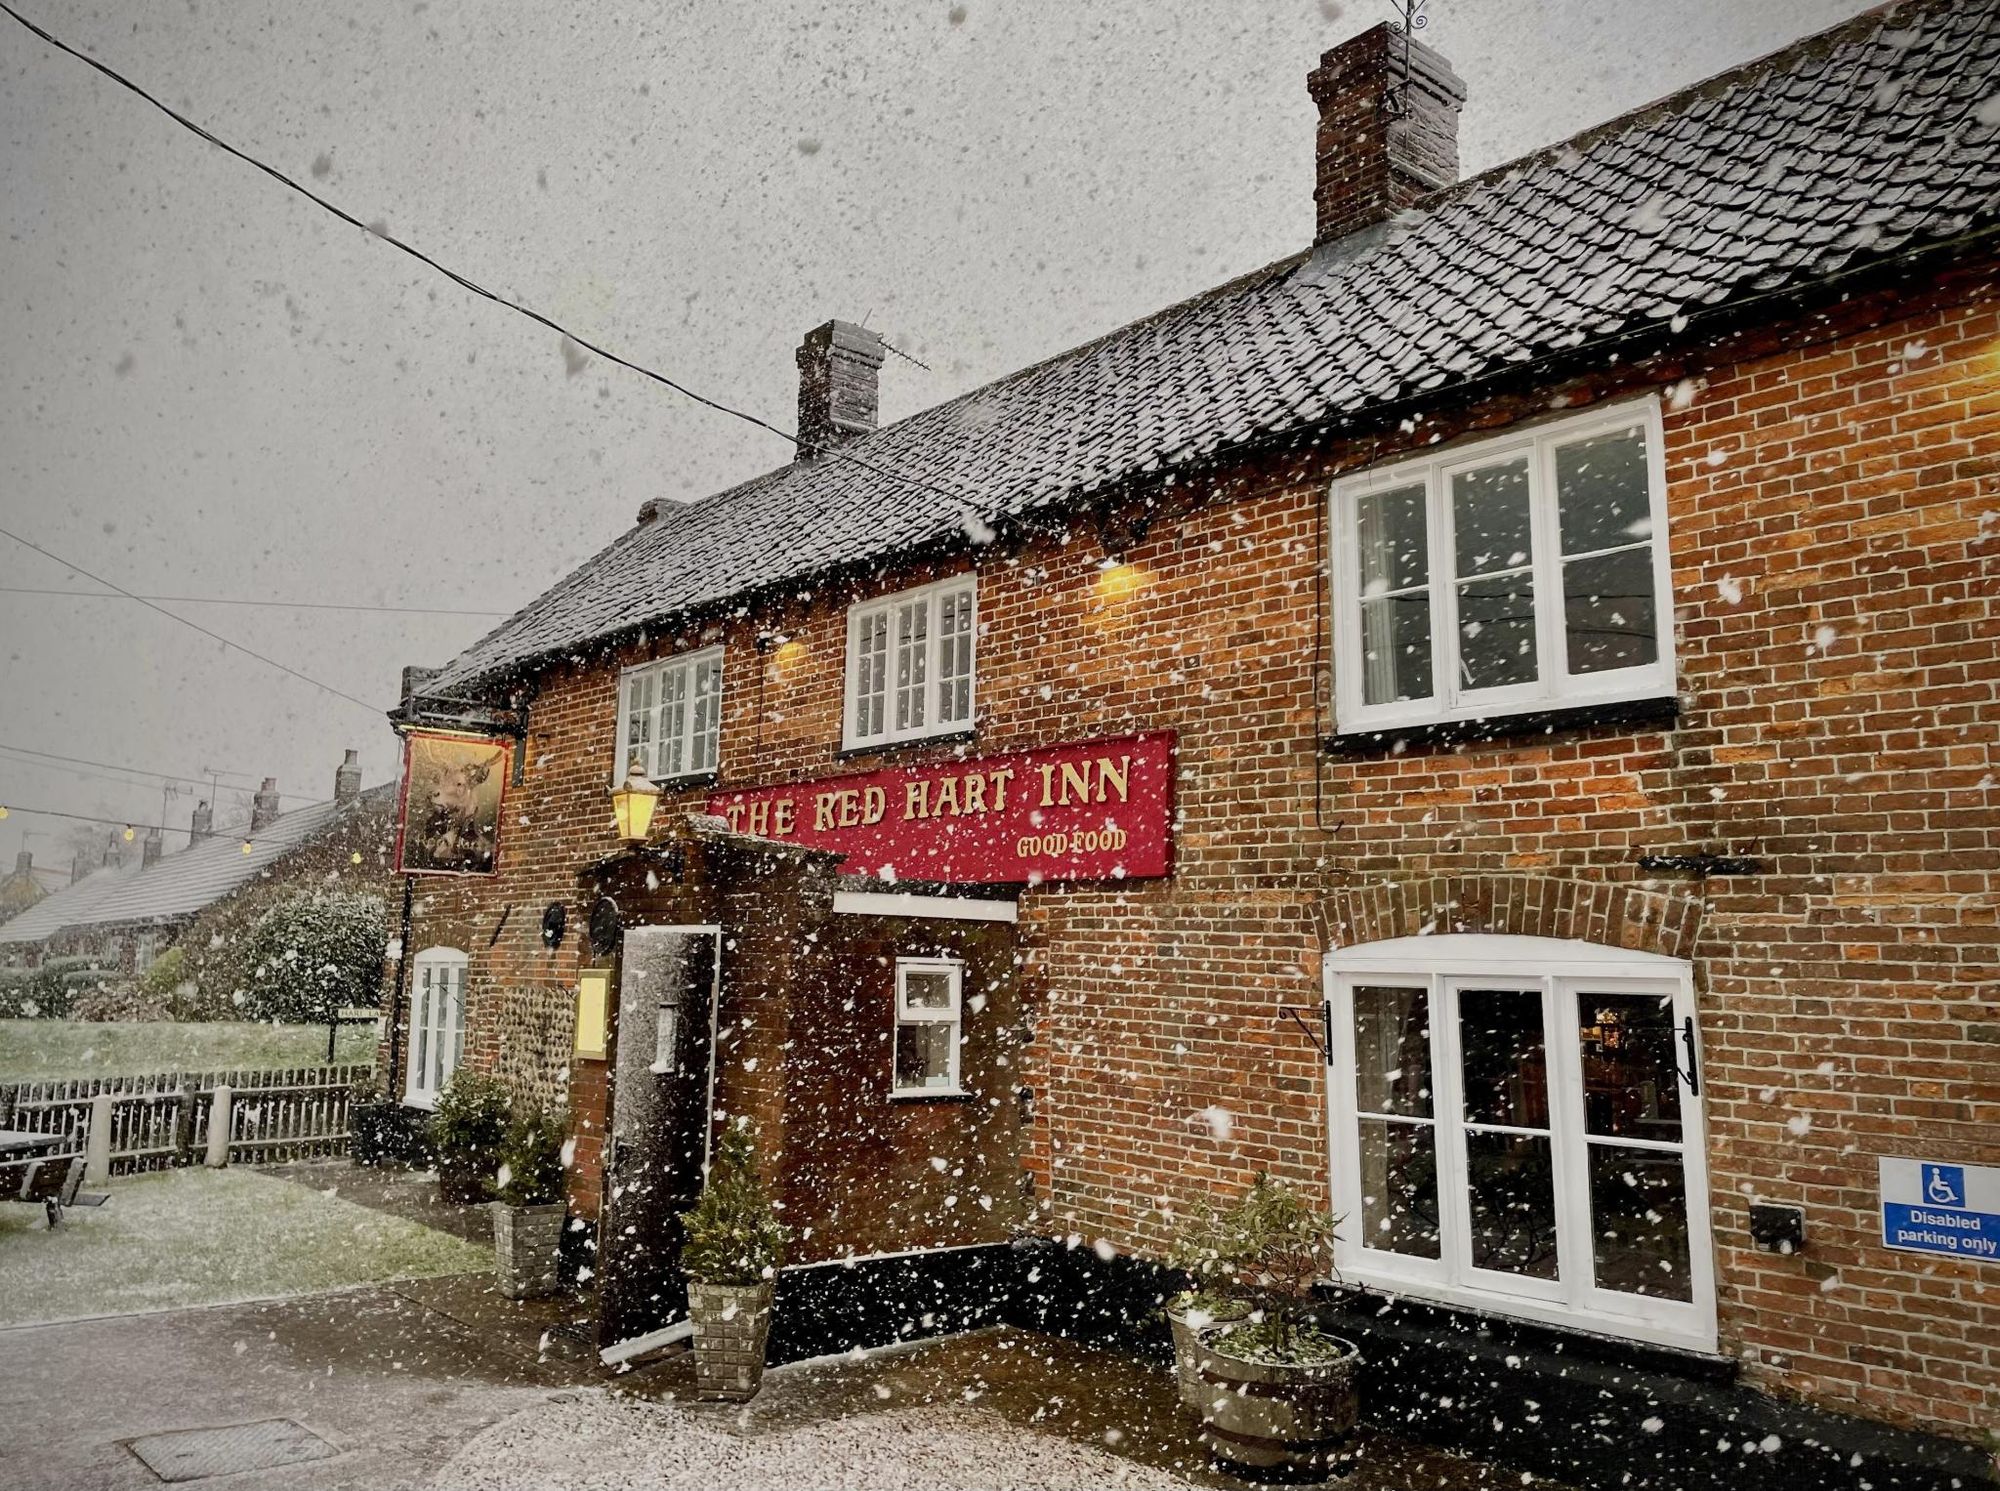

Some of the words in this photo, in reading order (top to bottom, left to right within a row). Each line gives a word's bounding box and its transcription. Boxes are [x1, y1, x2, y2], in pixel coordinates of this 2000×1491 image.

[727, 799, 794, 834] THE
[815, 787, 886, 831] RED
[903, 771, 1013, 819] HART
[1039, 756, 1131, 806] INN
[1017, 835, 1068, 857] GOOD
[1070, 829, 1127, 852] FOOD
[1911, 1210, 1980, 1230] Disabled
[1898, 1230, 1957, 1249] parking
[1962, 1237, 1997, 1254] only
